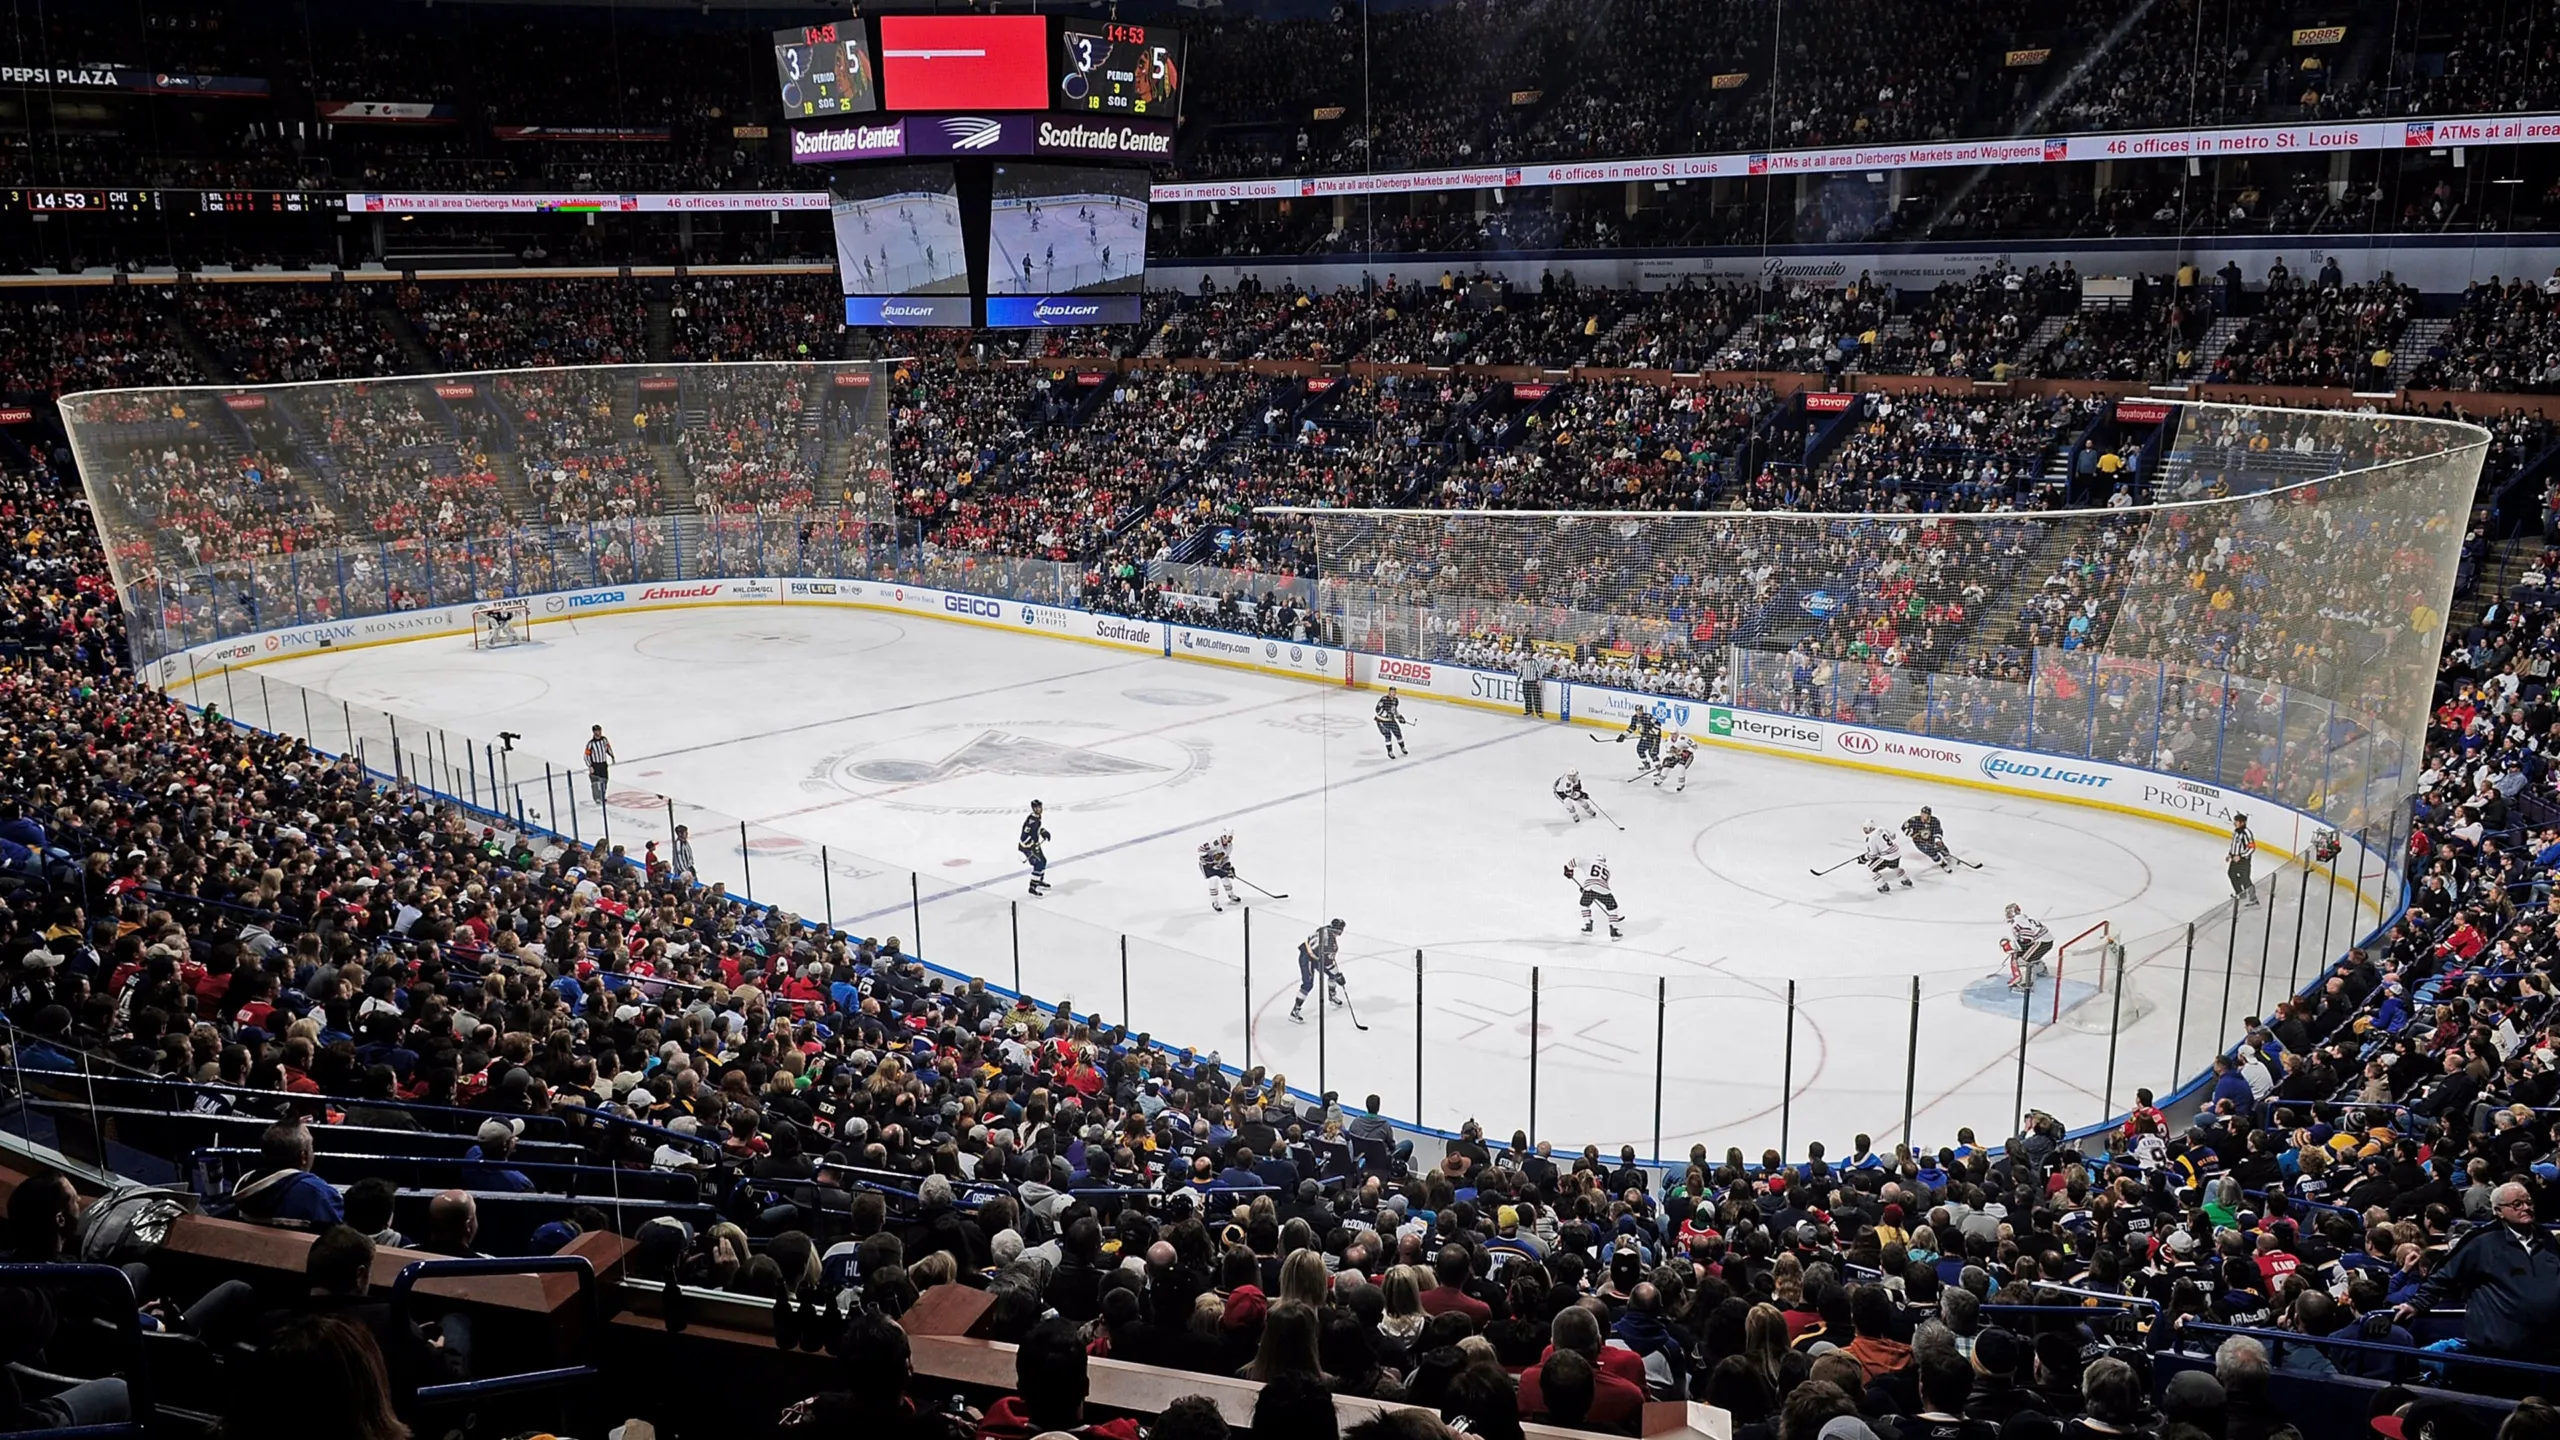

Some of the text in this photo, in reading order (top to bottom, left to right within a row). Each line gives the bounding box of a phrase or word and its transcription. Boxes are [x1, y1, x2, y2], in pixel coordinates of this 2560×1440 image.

[805, 26, 836, 45] 14:53
[1107, 25, 1144, 44] 14:53
[2298, 28, 2341, 40] DOBBS
[787, 40, 860, 80] 3 5
[1078, 39, 1167, 80] 3 5
[2011, 51, 2047, 62] DOBBS
[1, 66, 119, 86] PEPSI PLAZA
[812, 71, 835, 84] PERIOD
[1106, 70, 1134, 82] PERIOD
[1113, 83, 1120, 94] 3
[803, 97, 851, 115] 18 SOG 25
[1088, 95, 1146, 113] 18 SOG 25
[794, 125, 901, 154] Scottrade Center
[1038, 122, 1169, 153] Scottrade Center
[2439, 123, 2560, 140] ATMs at all area
[2107, 130, 2359, 154] 46 offices in metro St. Louis
[1771, 144, 2041, 169] ATMs at all area Dierbergs Markets and Walgreens
[1547, 162, 1718, 181] 46 offices in metro St. Louis
[1317, 181, 1337, 191] ATMs
[1338, 180, 1347, 190] at
[1347, 180, 1357, 190] all
[1357, 180, 1374, 190] area
[1376, 177, 1412, 191] Dierbergs
[1413, 176, 1443, 187] Markets
[1445, 175, 1460, 185] and
[1461, 172, 1503, 186] Walgreens
[1184, 186, 1194, 198] in
[1196, 186, 1226, 197] metro
[1229, 185, 1244, 197] St.
[1248, 184, 1276, 196] Louis
[36, 193, 86, 208] 14:53
[109, 192, 128, 202] CHI
[139, 192, 147, 202] 5
[386, 199, 414, 208] ATMs
[416, 199, 426, 208] at
[428, 199, 440, 208] all
[441, 199, 463, 208] area
[469, 198, 510, 211] Dierbergs
[667, 198, 682, 208] 46
[685, 197, 725, 208] offices
[728, 197, 740, 208] in
[744, 197, 778, 208] metro
[782, 196, 798, 208] St.
[2309, 250, 2324, 263] 105
[1643, 271, 1676, 279] Missouri's
[1724, 271, 1745, 280] Group
[1763, 258, 1846, 277] Bommarito
[1873, 268, 1967, 277] WHERE PRICE SELLS CARS
[1038, 305, 1099, 316] BUD LIGHT
[845, 376, 870, 384] TOYOTA
[445, 387, 474, 395] TOYOTA
[1, 412, 33, 420] TOYOTA
[638, 585, 723, 600] Schnucks
[791, 583, 808, 592] FOX
[810, 584, 836, 593] LIVE
[568, 591, 625, 607] mazda
[944, 595, 1001, 618] GEICO
[1810, 595, 1834, 604] BUD
[1035, 608, 1067, 620] EXPRESS
[1035, 616, 1068, 628] SCRIPTS
[364, 615, 443, 634] MONSANTO
[1096, 620, 1151, 643] Scottrade
[281, 625, 356, 647] PNC BANK
[216, 644, 256, 660] verizon
[1195, 636, 1251, 655] MOLottery.com
[1379, 659, 1432, 679] DOBBS
[1470, 672, 1525, 704] STIFE
[1561, 682, 1570, 714] Reebok
[1714, 717, 1820, 743] enterprise
[1844, 735, 1871, 751] KIA
[1884, 742, 1962, 764] KIA MOTORS
[1988, 758, 2113, 788] BUD LIGHT
[2185, 783, 2220, 799] PURINA
[1590, 864, 1610, 881] 65
[2127, 1218, 2151, 1231] STEEN
[2114, 1318, 2134, 1332] 113
[2368, 1319, 2389, 1335] 112
